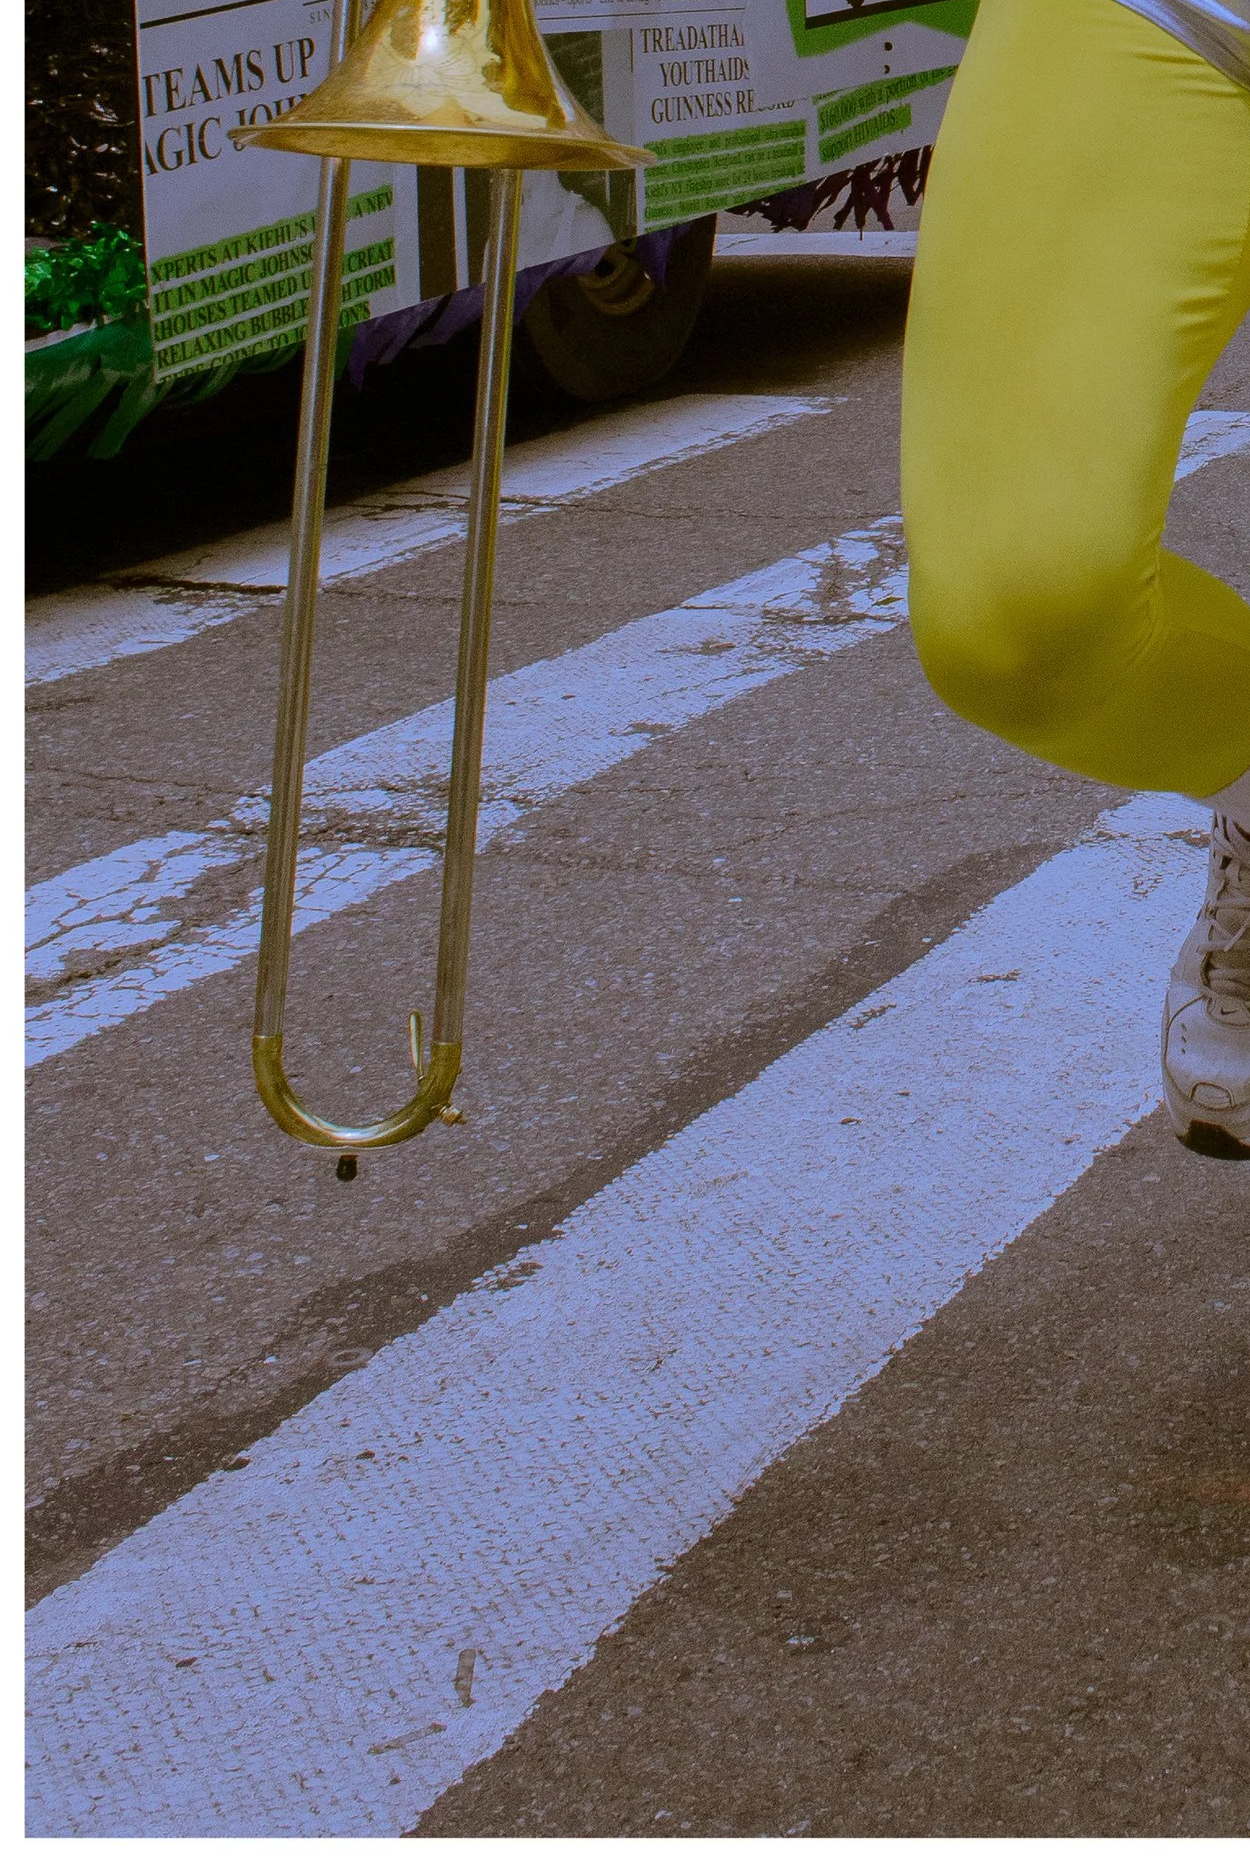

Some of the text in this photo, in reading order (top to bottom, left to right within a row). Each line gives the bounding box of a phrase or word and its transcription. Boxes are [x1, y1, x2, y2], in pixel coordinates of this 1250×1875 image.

[142, 37, 315, 119] TEAMS UP
[651, 90, 733, 125] GUINNESS
[222, 240, 242, 262] AT
[247, 221, 309, 256] KIEHL'S
[177, 285, 197, 308] IN
[200, 263, 257, 298] MAGIC
[155, 305, 227, 342] HOUSES
[232, 277, 298, 318] TEAMED
[158, 326, 247, 369] RELAXING
